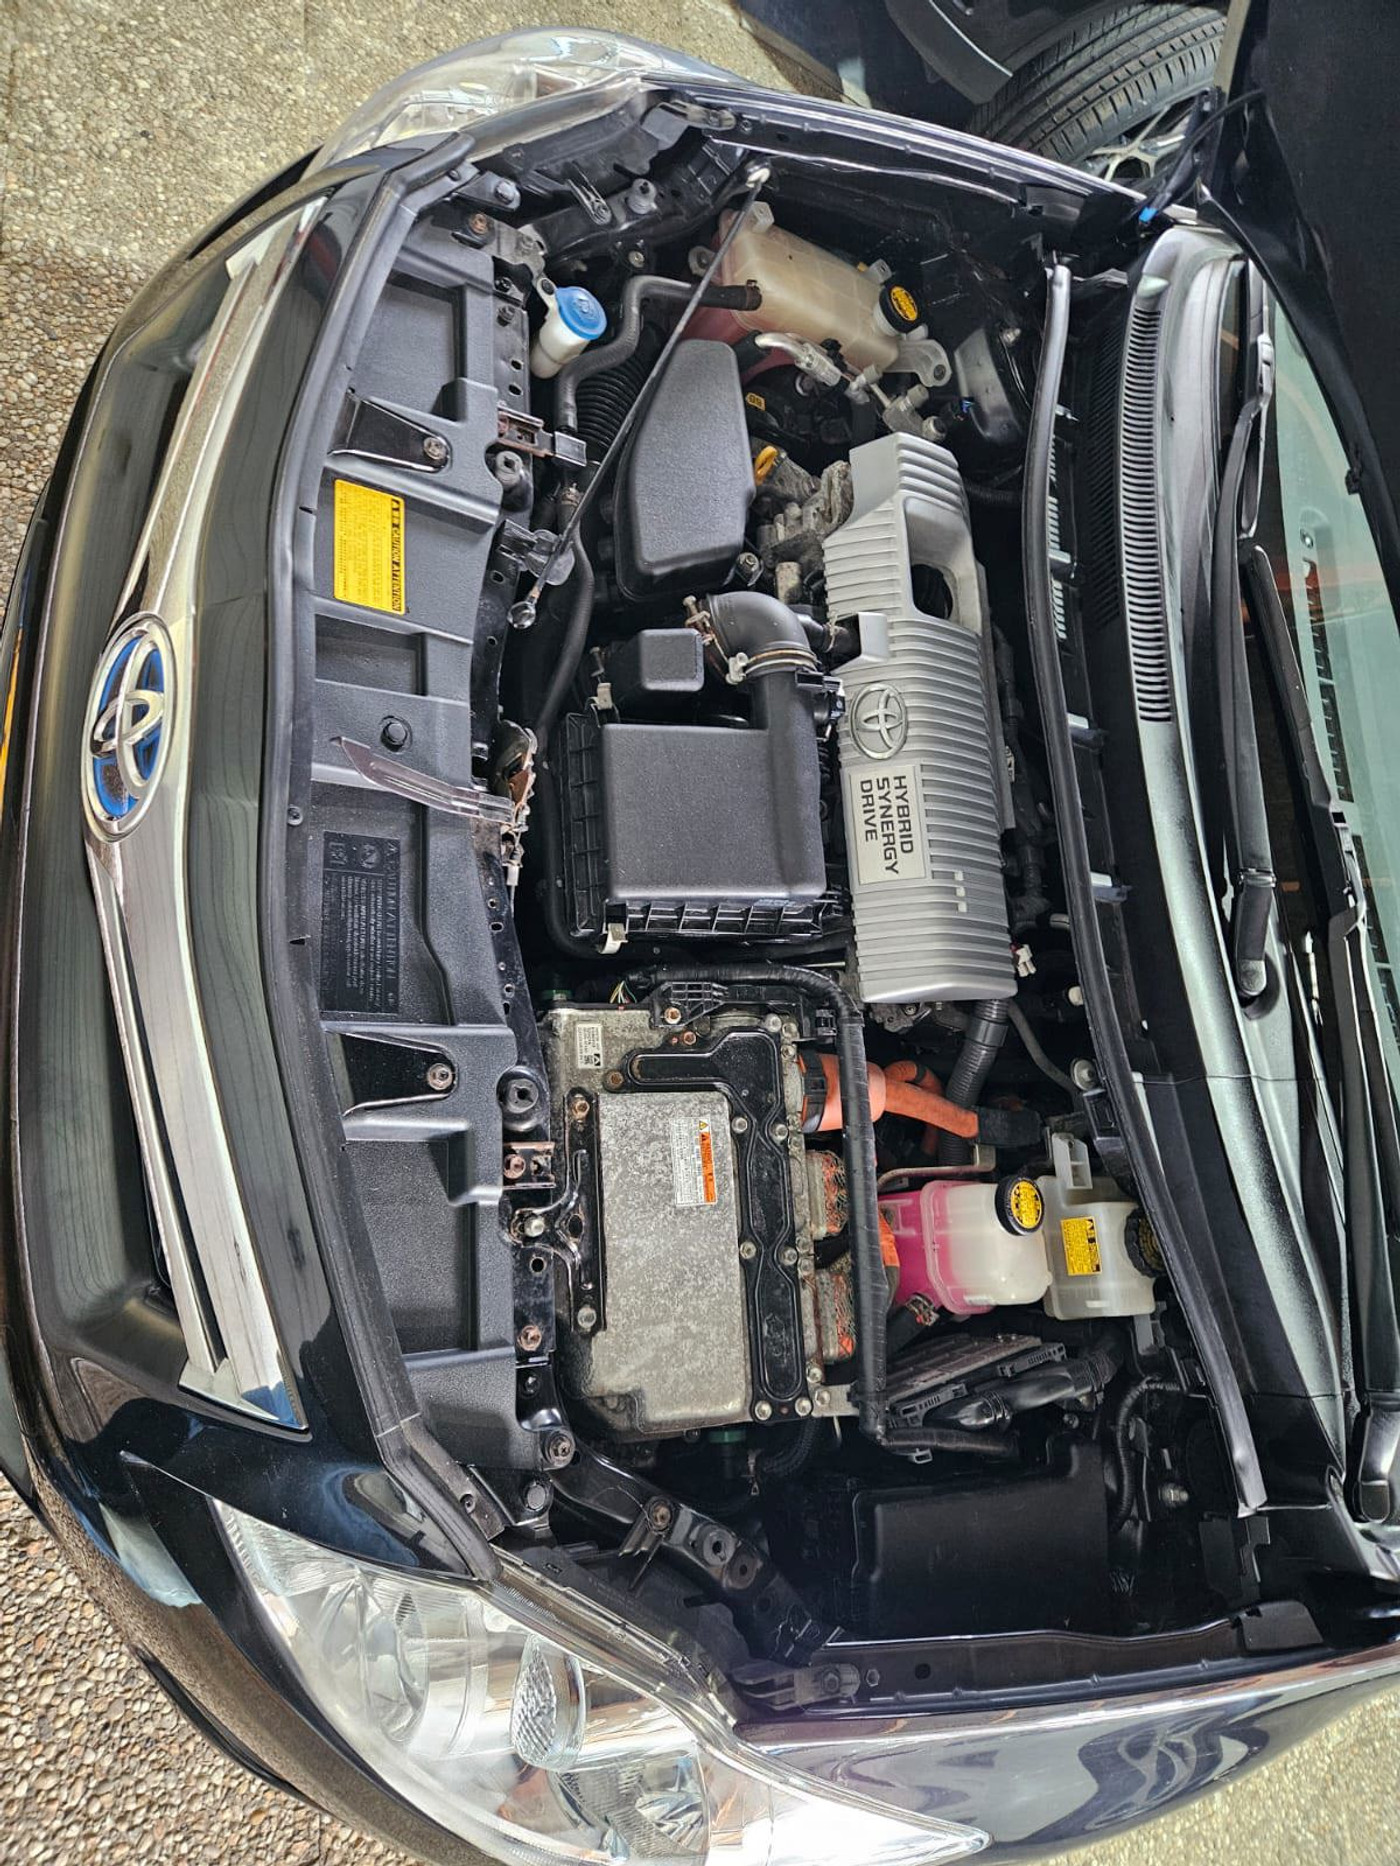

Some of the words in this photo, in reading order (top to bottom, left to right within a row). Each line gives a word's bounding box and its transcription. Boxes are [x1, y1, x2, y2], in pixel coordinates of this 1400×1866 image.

[860, 779, 878, 842] DRIVE
[876, 777, 899, 874] SYNERGY
[893, 775, 914, 854] HYBRID
